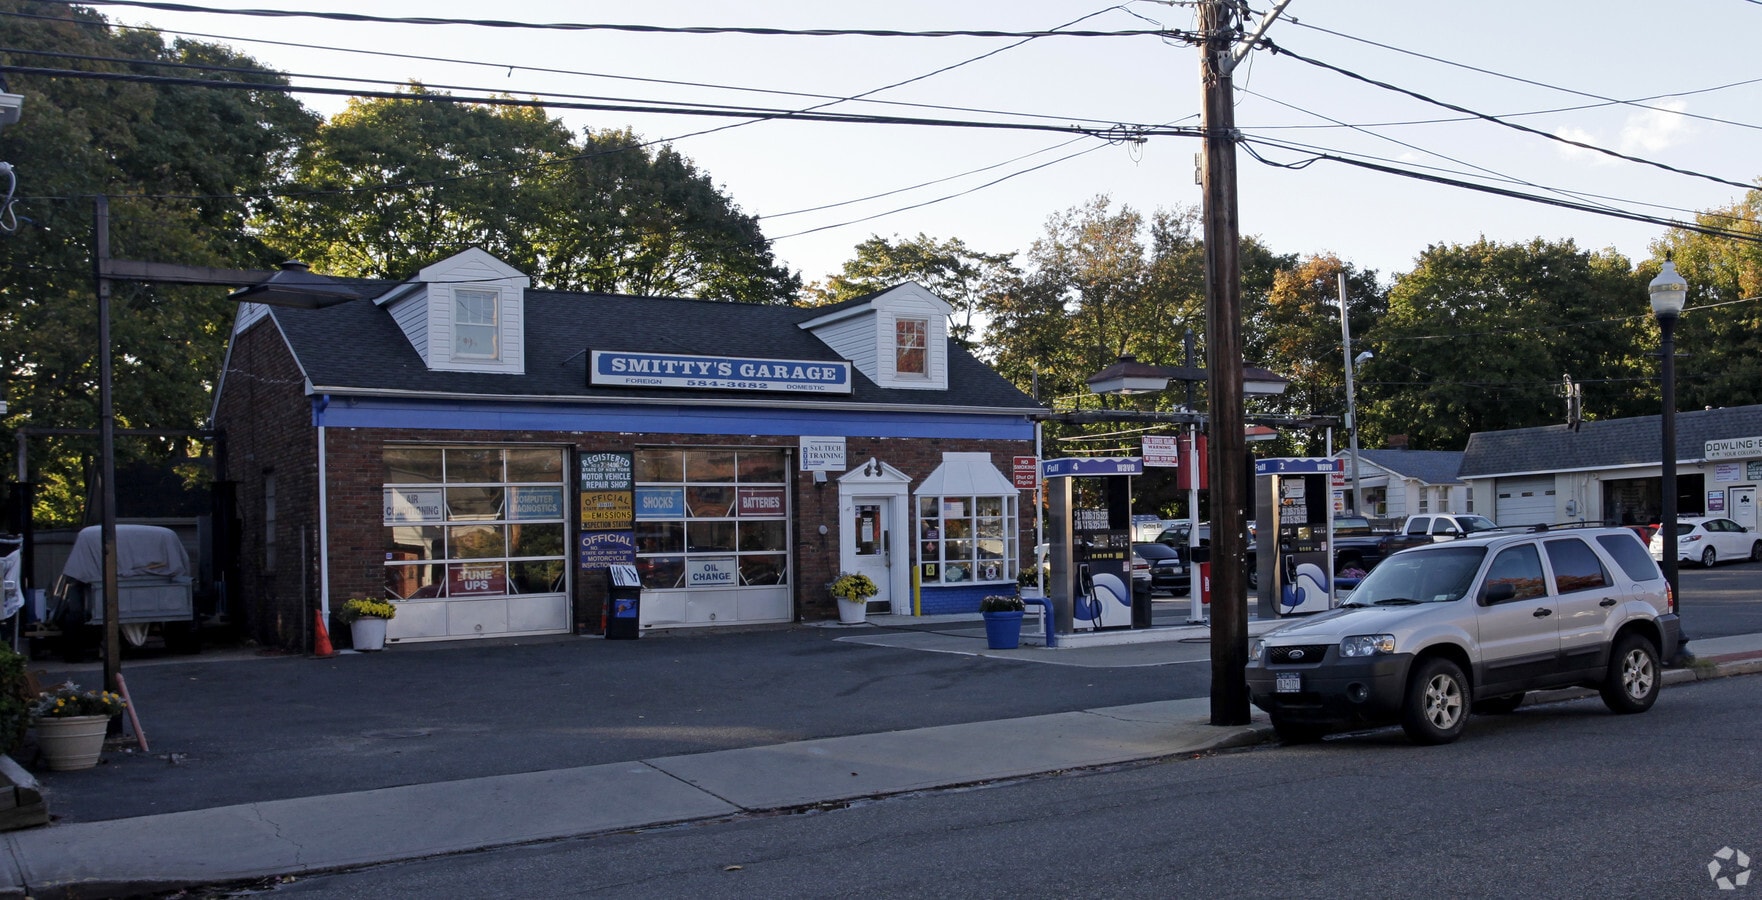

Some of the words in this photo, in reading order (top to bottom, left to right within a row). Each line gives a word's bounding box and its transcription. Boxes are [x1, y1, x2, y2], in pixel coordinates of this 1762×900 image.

[612, 358, 732, 376] SMITTY'S
[740, 364, 836, 380] GARAGE
[687, 380, 768, 389] 584-3682
[1706, 440, 1753, 451] DOWLING
[581, 453, 630, 467] REGISTERED
[1047, 464, 1059, 472] Full
[1072, 462, 1079, 471] 4
[1117, 464, 1135, 472] wave
[1317, 463, 1332, 471] wave
[586, 481, 608, 489] REPAIR
[610, 481, 628, 489] SHOP
[406, 495, 419, 504] AIR
[513, 495, 554, 503] COMPUTER
[585, 494, 629, 506] OFFICIAL
[643, 497, 673, 509] SHOCKS
[742, 497, 780, 509] BATTERIES
[386, 506, 439, 516] CONDITIONING
[510, 504, 558, 513] DIAGNOSTICS
[591, 511, 632, 519] EMISSIONS
[582, 534, 631, 547] OFFICIAL
[460, 570, 493, 580] TUNE
[692, 573, 732, 581] CHANGE
[464, 580, 489, 590] UPS
